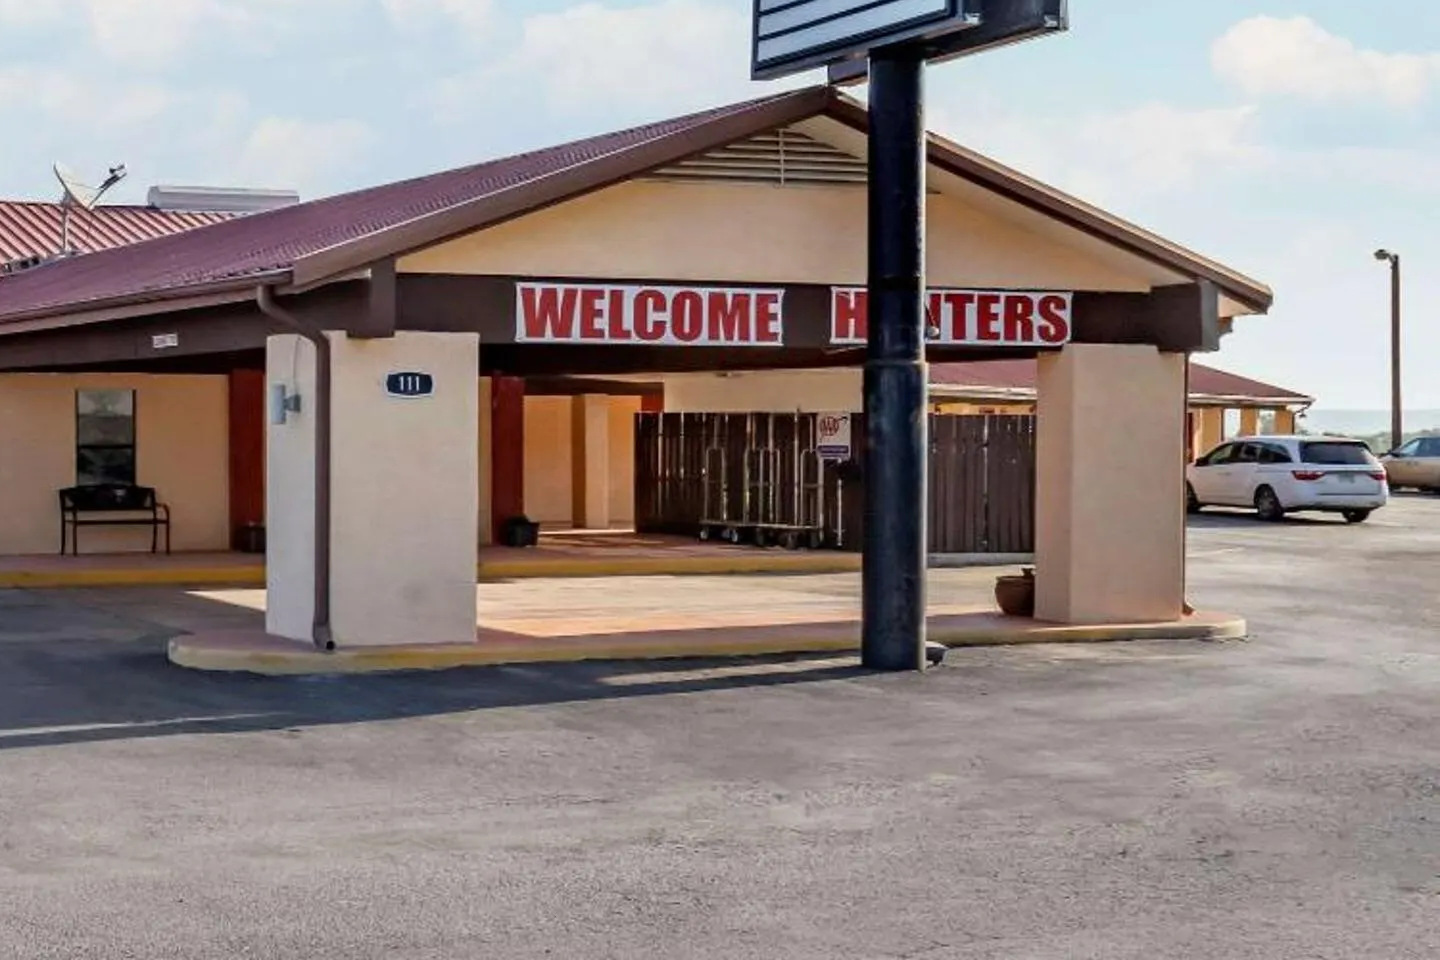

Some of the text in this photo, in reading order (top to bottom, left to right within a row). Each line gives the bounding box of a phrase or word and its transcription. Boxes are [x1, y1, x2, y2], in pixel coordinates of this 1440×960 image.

[520, 287, 1068, 343] WELCOME HTERS
[398, 375, 420, 391] 111
